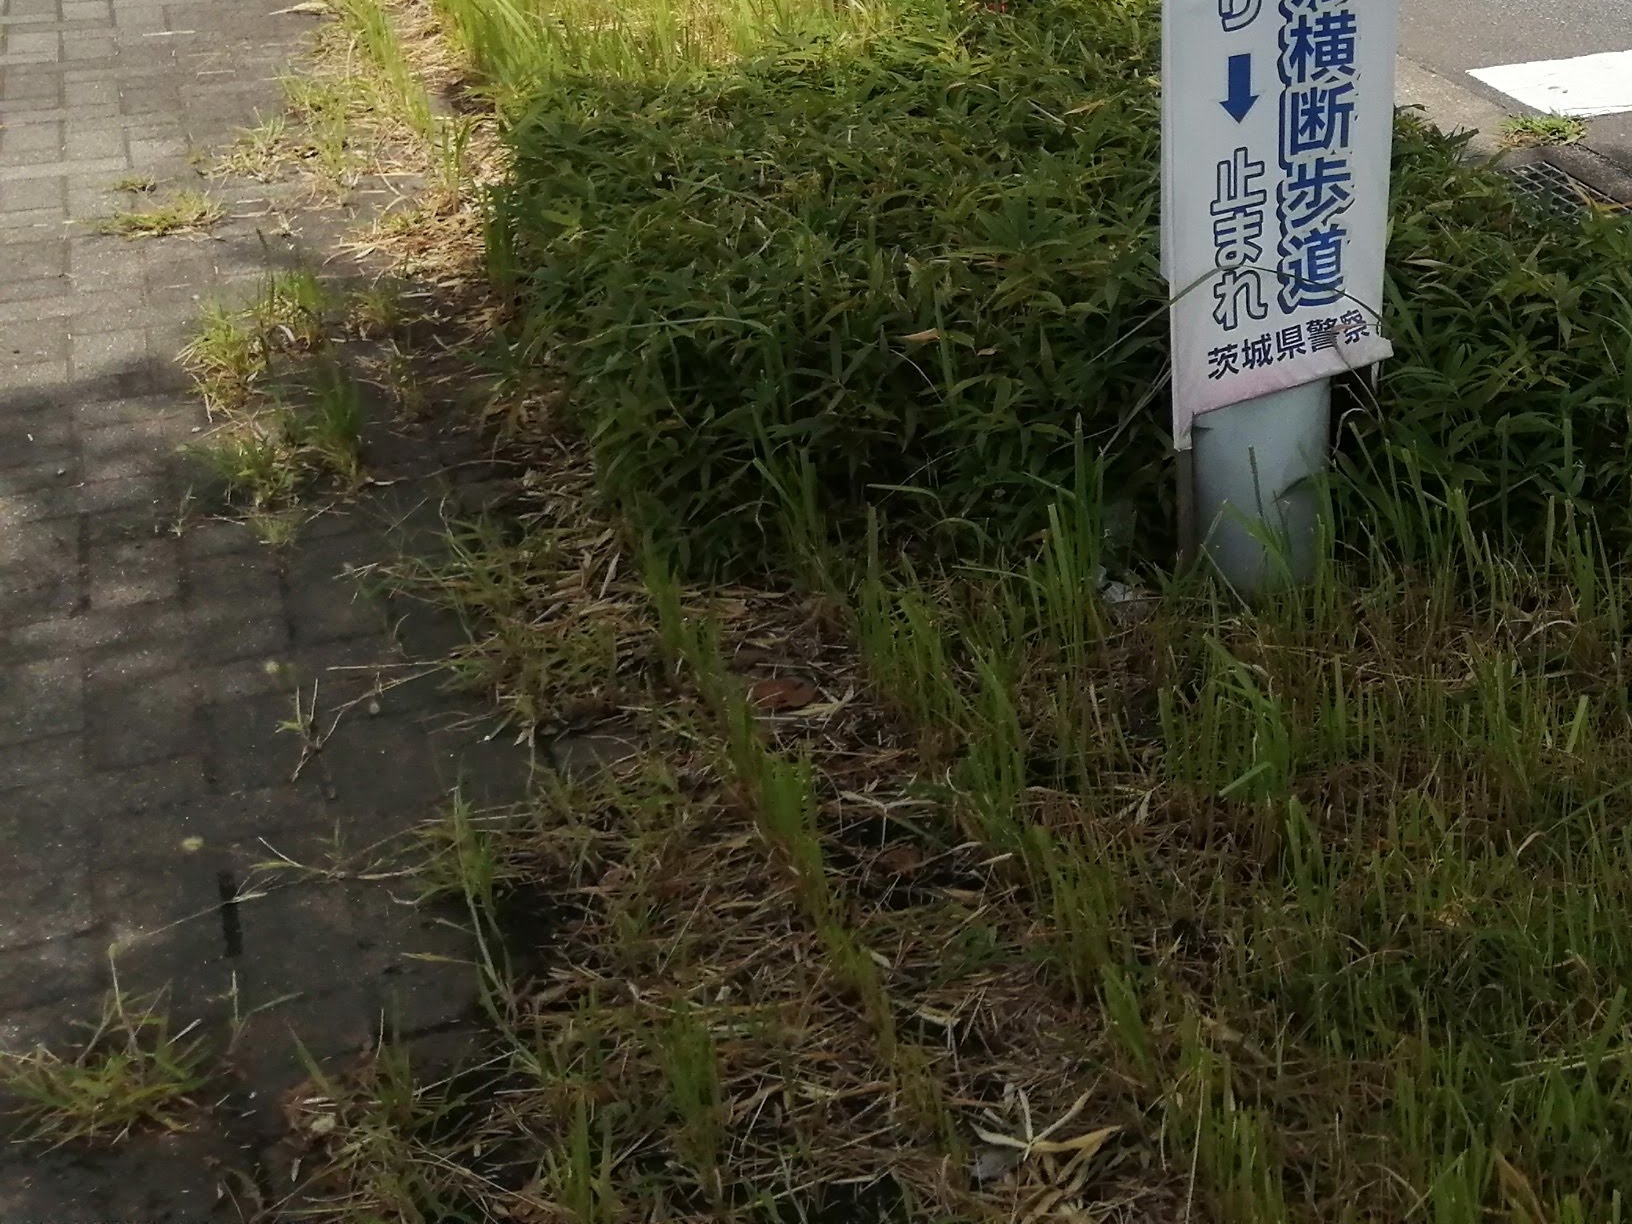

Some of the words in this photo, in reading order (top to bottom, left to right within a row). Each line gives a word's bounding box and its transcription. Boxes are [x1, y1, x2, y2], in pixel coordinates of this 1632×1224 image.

[1210, 146, 1269, 331] 止まれ
[1207, 308, 1371, 381] 茨城県警察
